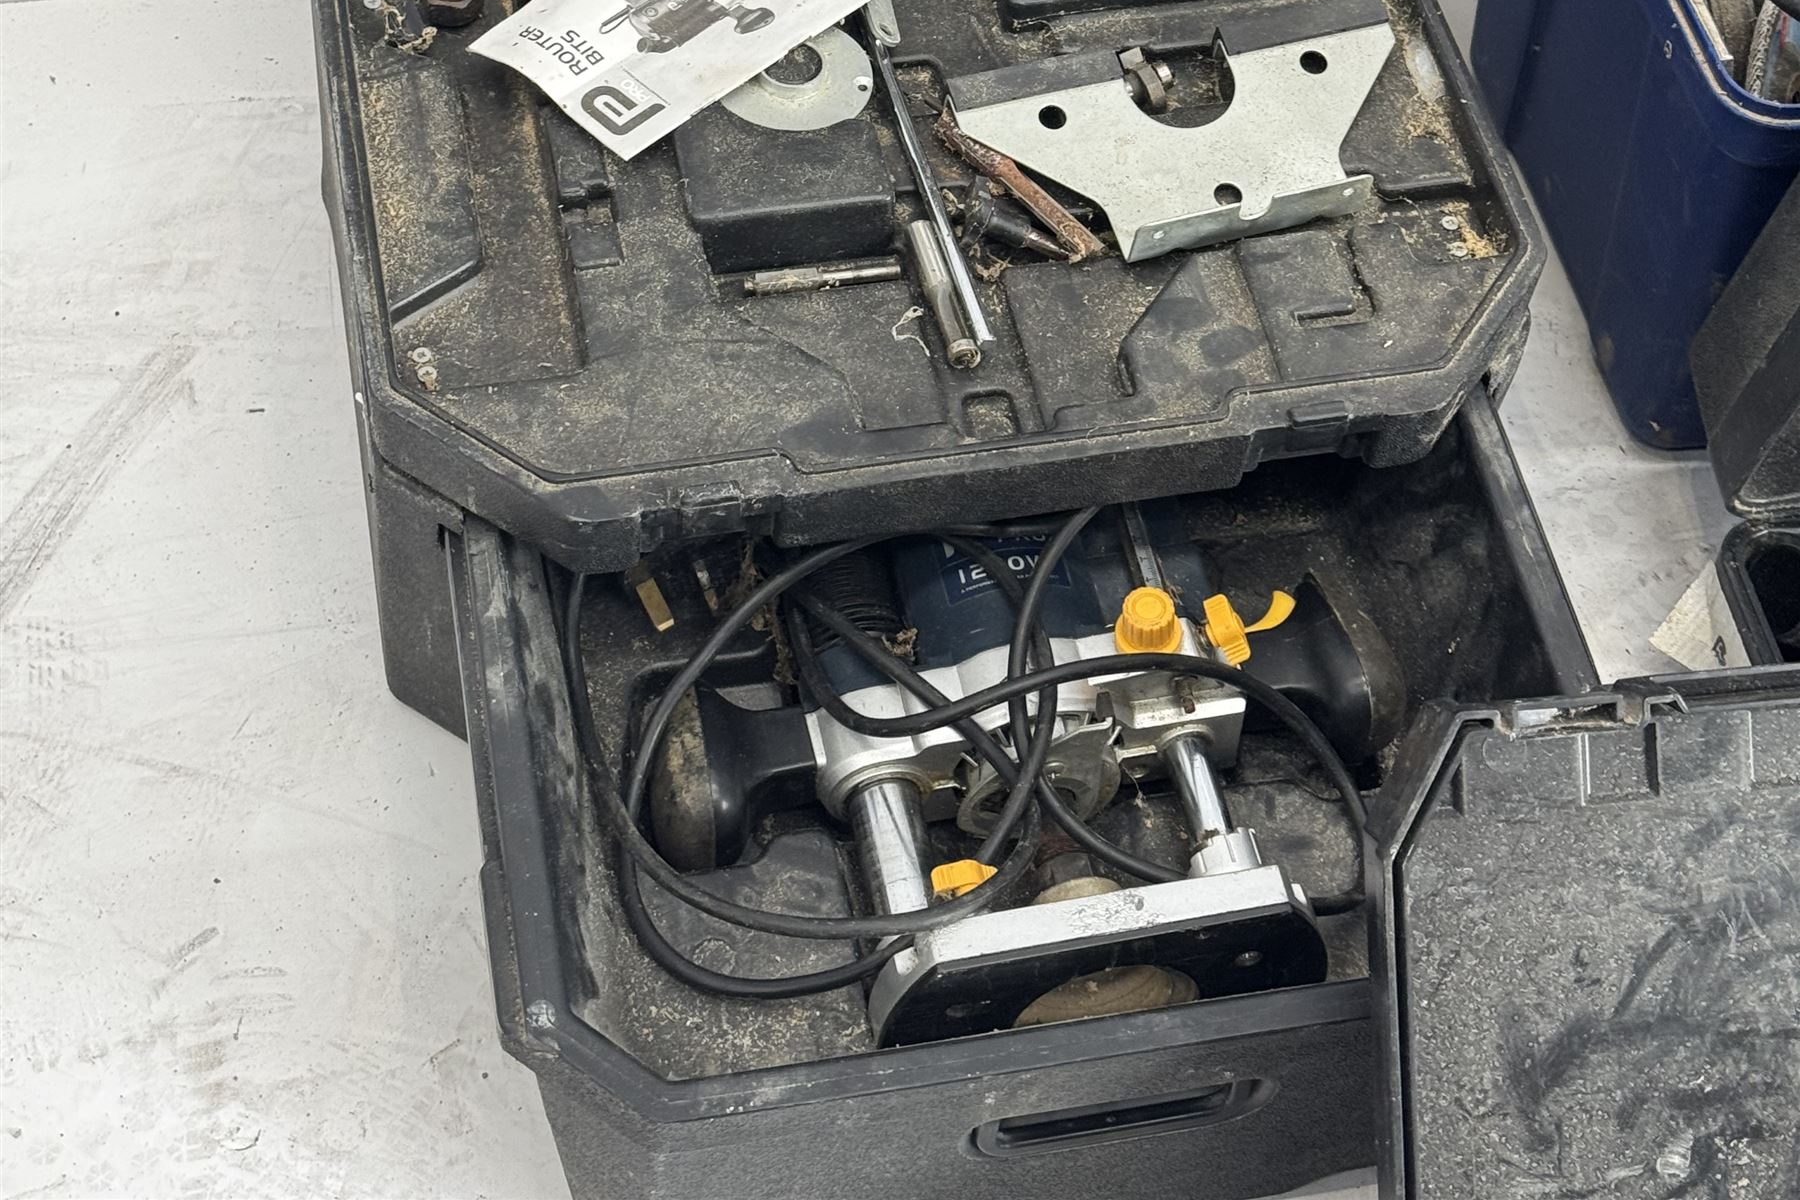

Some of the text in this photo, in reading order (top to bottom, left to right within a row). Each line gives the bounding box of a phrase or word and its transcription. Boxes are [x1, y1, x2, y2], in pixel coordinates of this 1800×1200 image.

[519, 26, 588, 76] ROUTER
[560, 29, 605, 66] BITS
[620, 78, 651, 101] PRO
